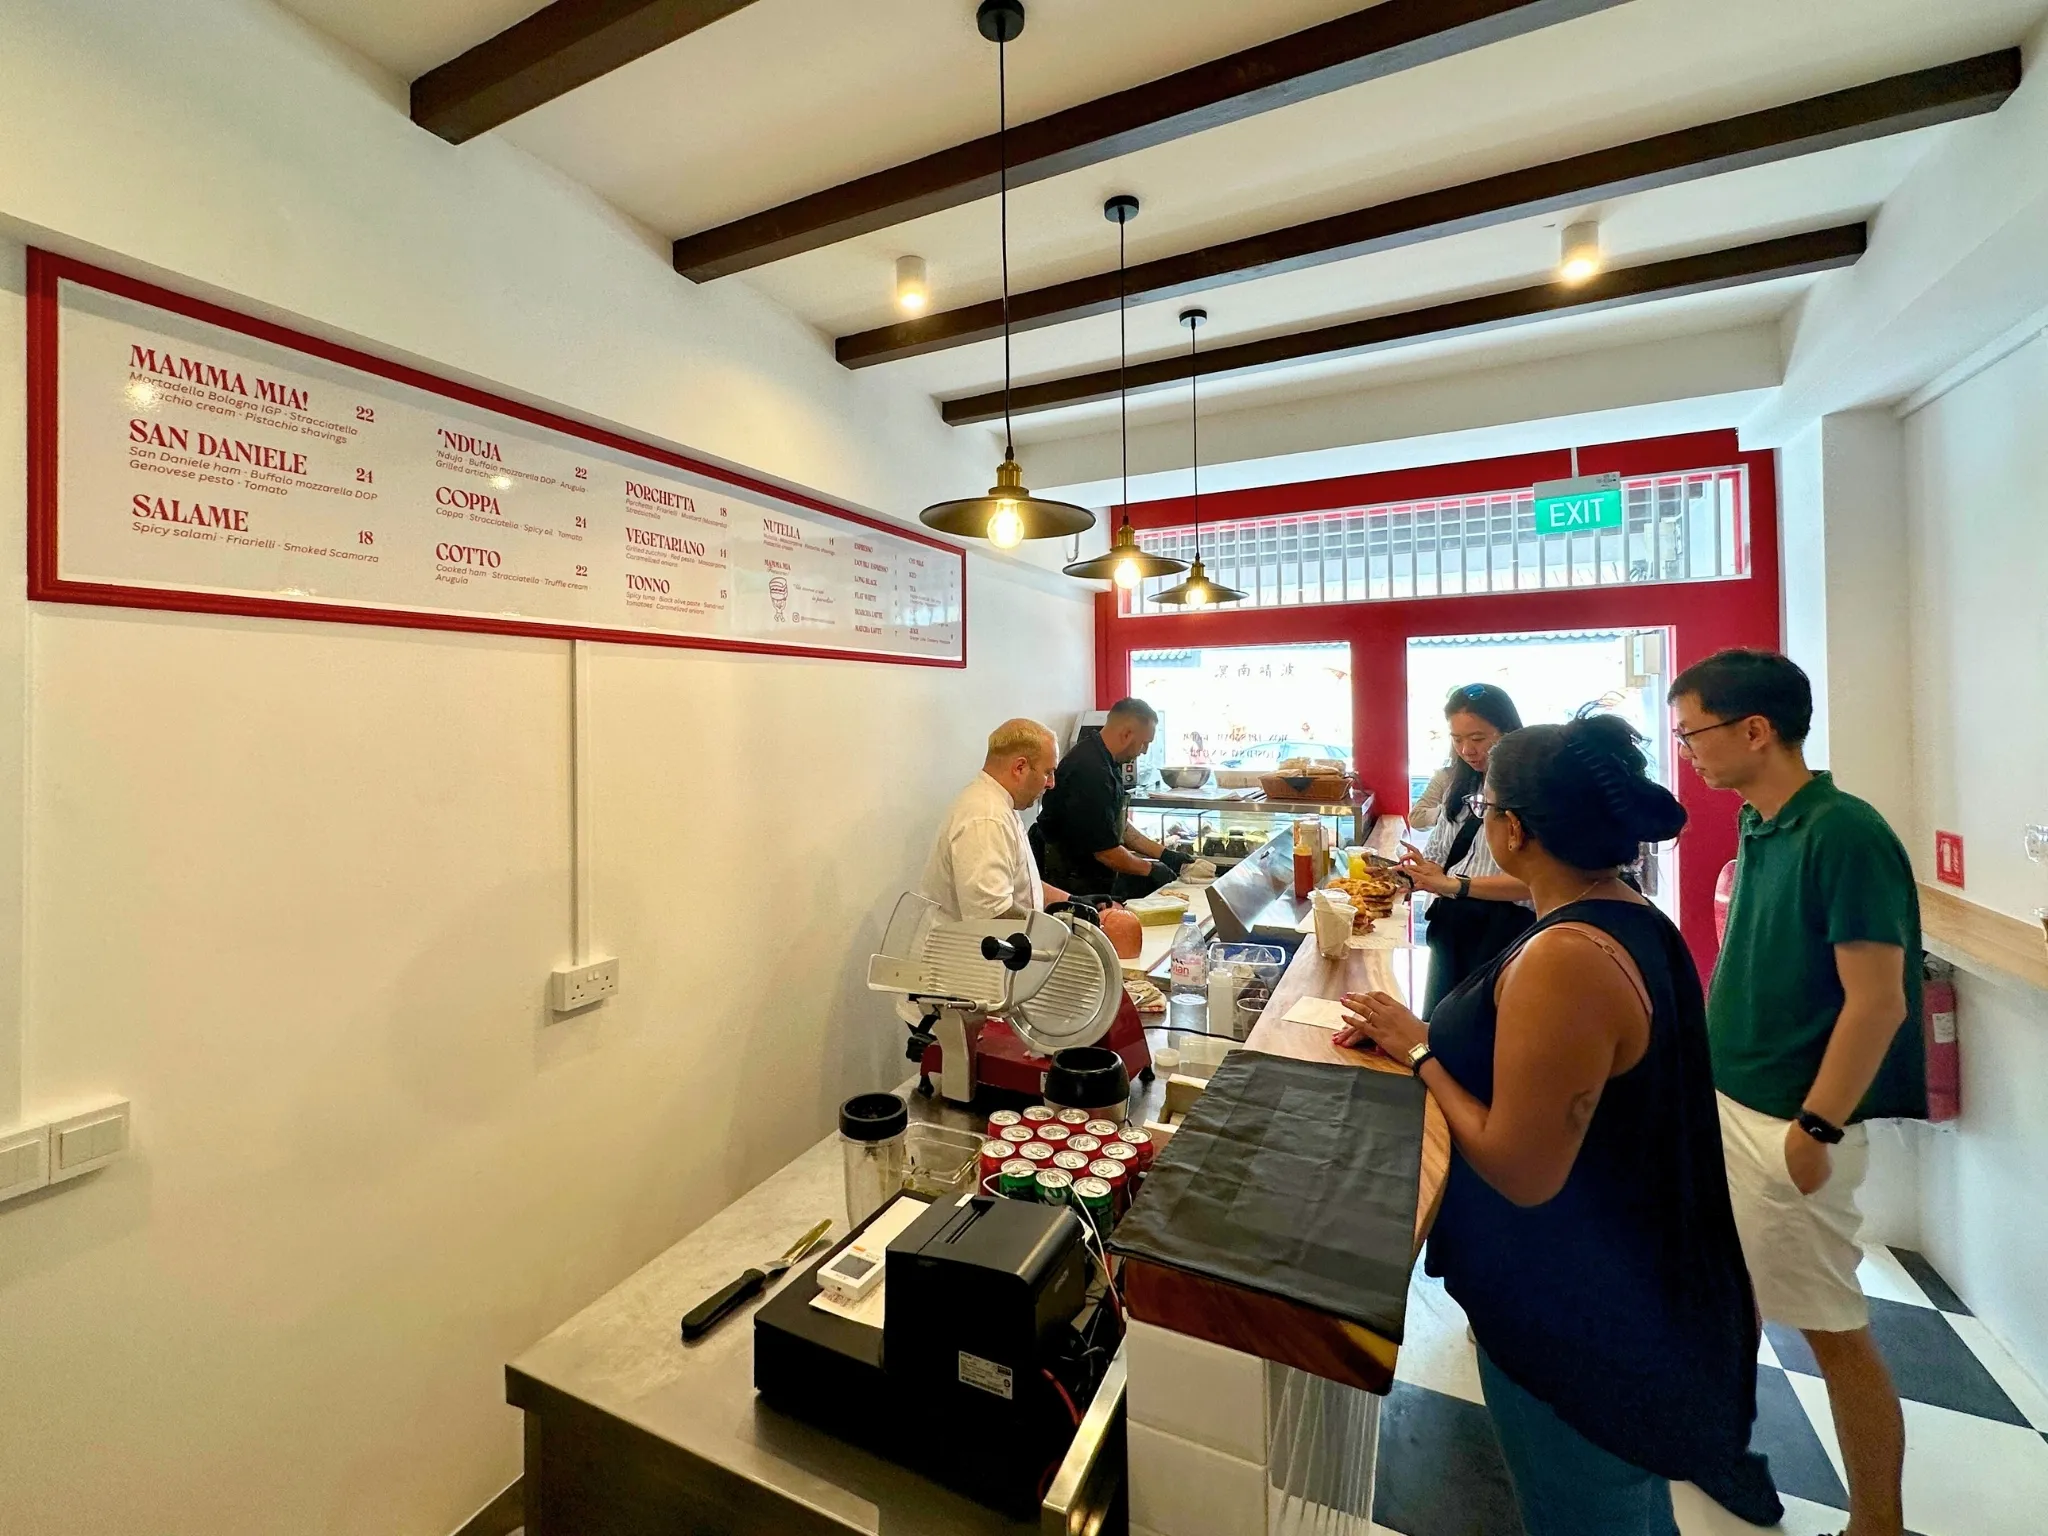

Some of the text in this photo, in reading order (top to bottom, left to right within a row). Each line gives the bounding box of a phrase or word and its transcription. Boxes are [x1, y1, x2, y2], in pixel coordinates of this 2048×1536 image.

[129, 344, 309, 411] MAMMA MIA!
[129, 372, 358, 435] Mortadella Bologna IGP Stracciatella
[356, 405, 374, 422] 22
[196, 402, 236, 417] cream
[245, 412, 298, 432] Pistachio
[301, 425, 347, 444] shavings
[129, 419, 307, 475] SAN DANIELE
[437, 428, 502, 462] 'NDUJA
[129, 446, 378, 500] San Daniele ham Buffalo mozzarella DOP
[129, 459, 288, 496] Genovese pesto Tomato
[356, 467, 373, 483] 24
[436, 459, 463, 472] Grilled
[469, 458, 498, 471] Buffalo
[500, 467, 539, 481] mozzarella
[540, 476, 556, 485] DOP
[560, 481, 586, 493] Arugula
[575, 466, 587, 479] 22
[435, 486, 501, 515] COPPA
[625, 481, 695, 512] PORCHETTA
[132, 493, 249, 532] SALAME
[436, 507, 463, 518] Coppa
[469, 513, 519, 529] Stracciatella
[524, 523, 543, 535] Spicy
[558, 530, 583, 541] Tomato
[575, 515, 587, 528] 24
[720, 507, 727, 517] 18
[1549, 498, 1604, 527] EXIT
[132, 521, 379, 563] Spicy salami Friarielli Smoked Scamorza
[358, 530, 374, 545] 18
[625, 527, 705, 556] VEGETARIANO
[763, 518, 800, 539] NUTELLA
[436, 542, 501, 568] COTTO
[435, 573, 468, 585] Arugula
[436, 563, 588, 590] Cooked ham Stracciatella Truffle cream
[575, 564, 588, 577] 22
[625, 574, 670, 594] TONNO
[625, 591, 641, 599] Spicy
